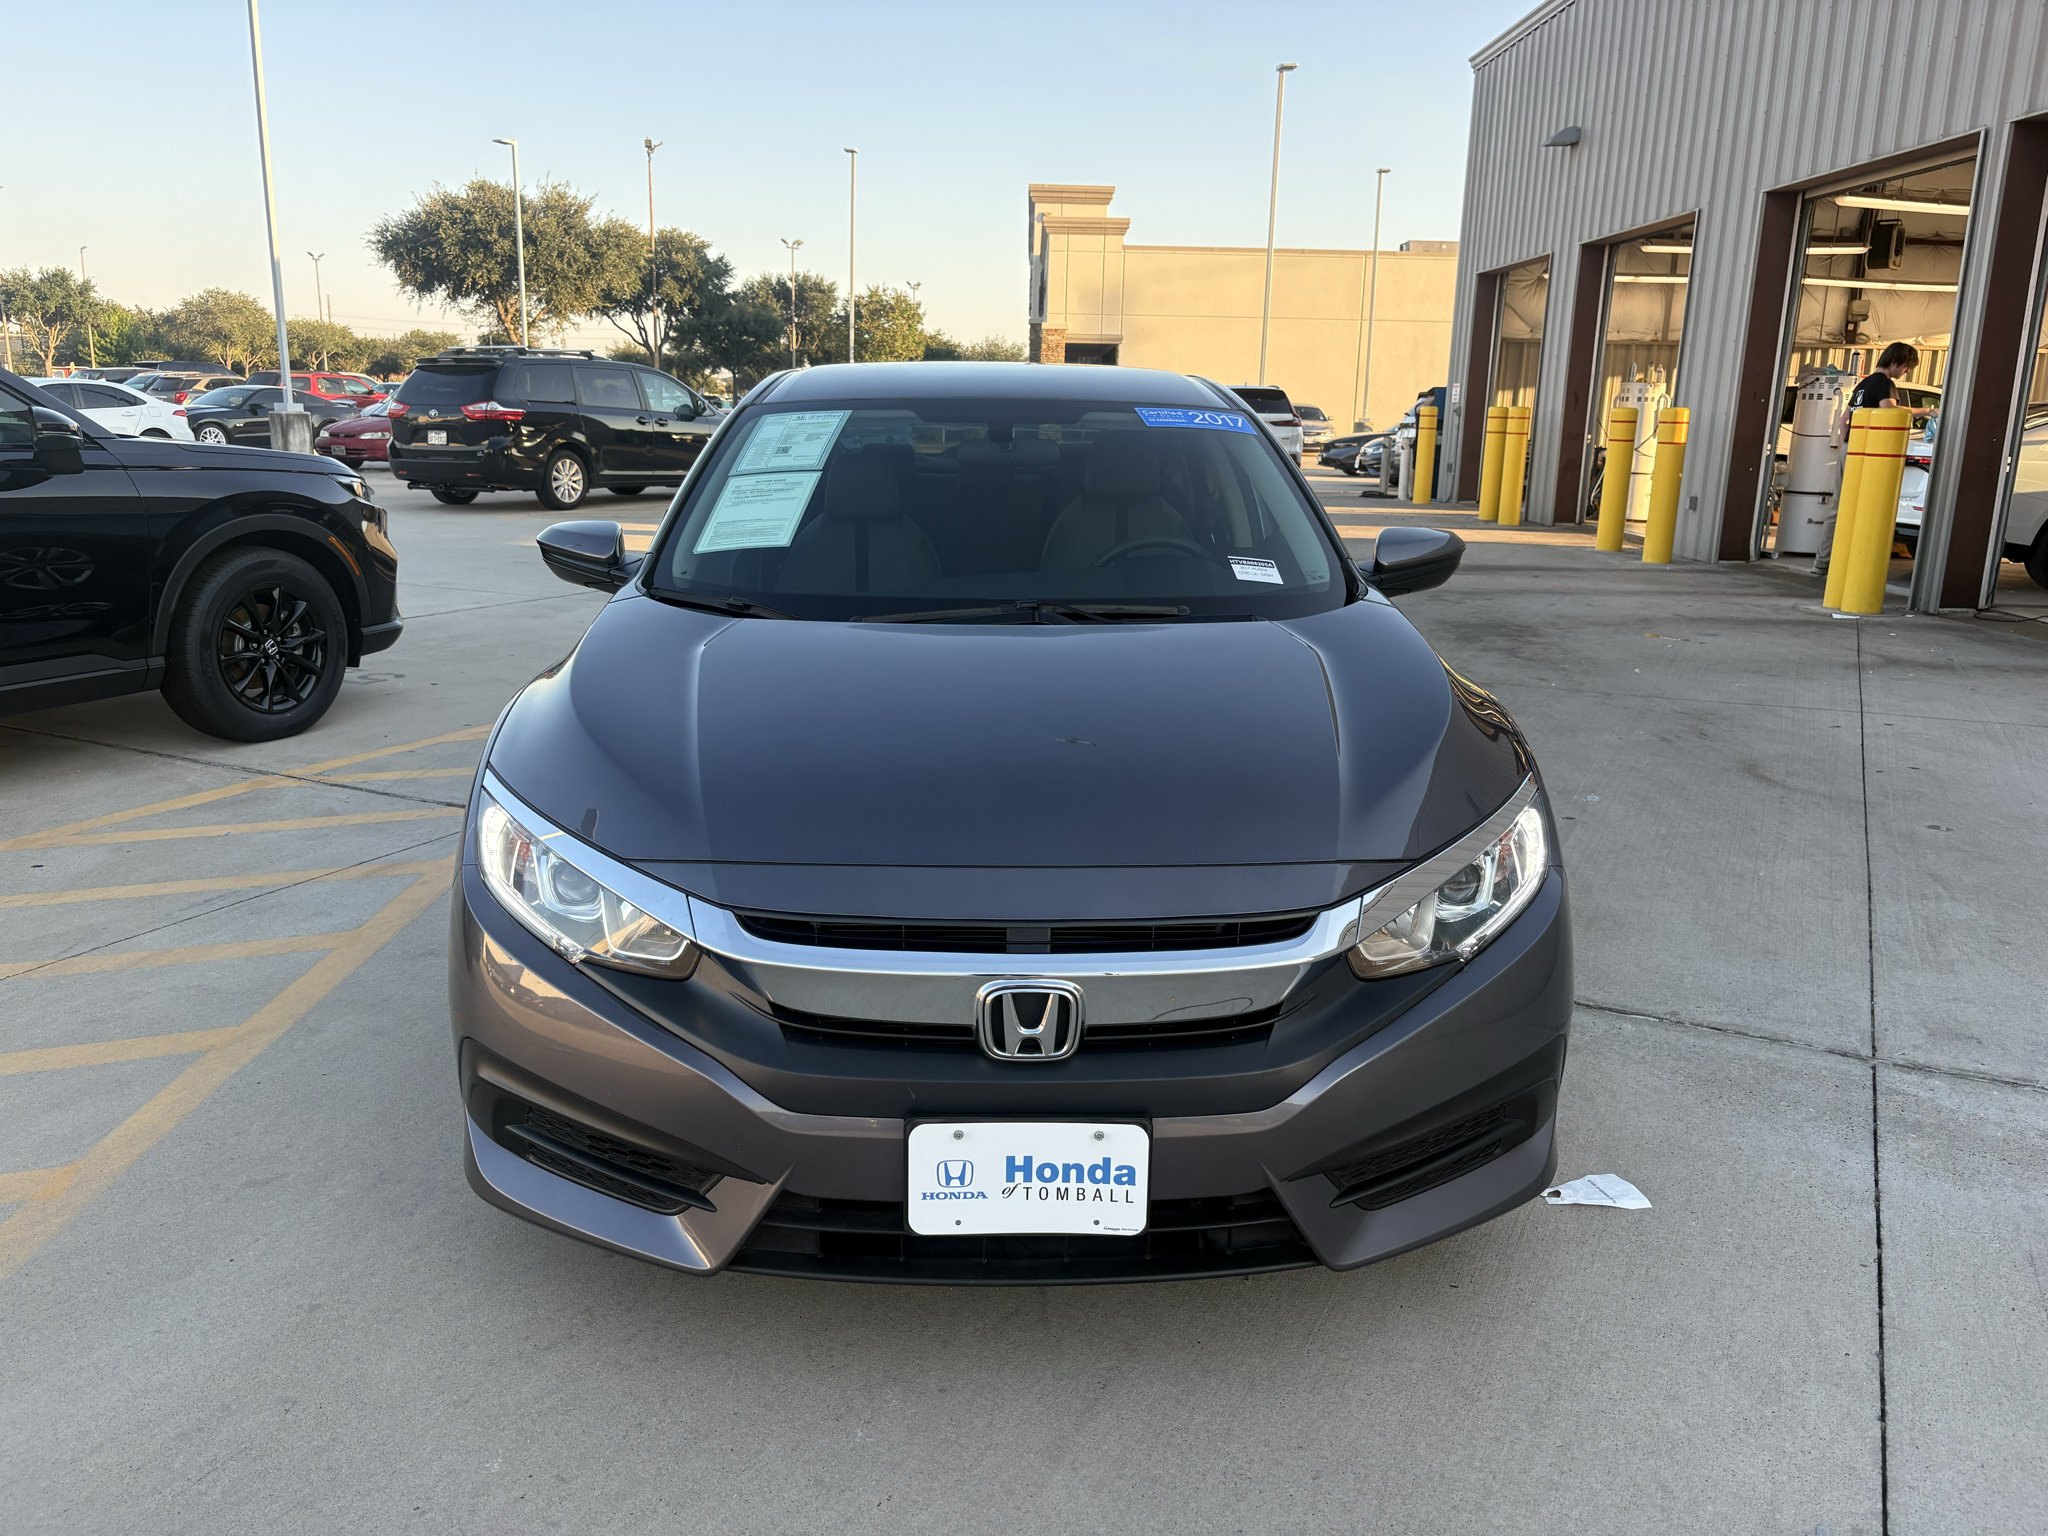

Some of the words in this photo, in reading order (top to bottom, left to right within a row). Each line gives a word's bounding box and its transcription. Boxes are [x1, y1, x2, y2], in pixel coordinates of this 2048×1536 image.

[1187, 411, 1243, 428] 2017
[1005, 1155, 1137, 1187] Honda
[920, 1191, 989, 1201] HONDA
[1001, 1182, 1022, 1199] of
[1023, 1186, 1135, 1204] TOMBALL
